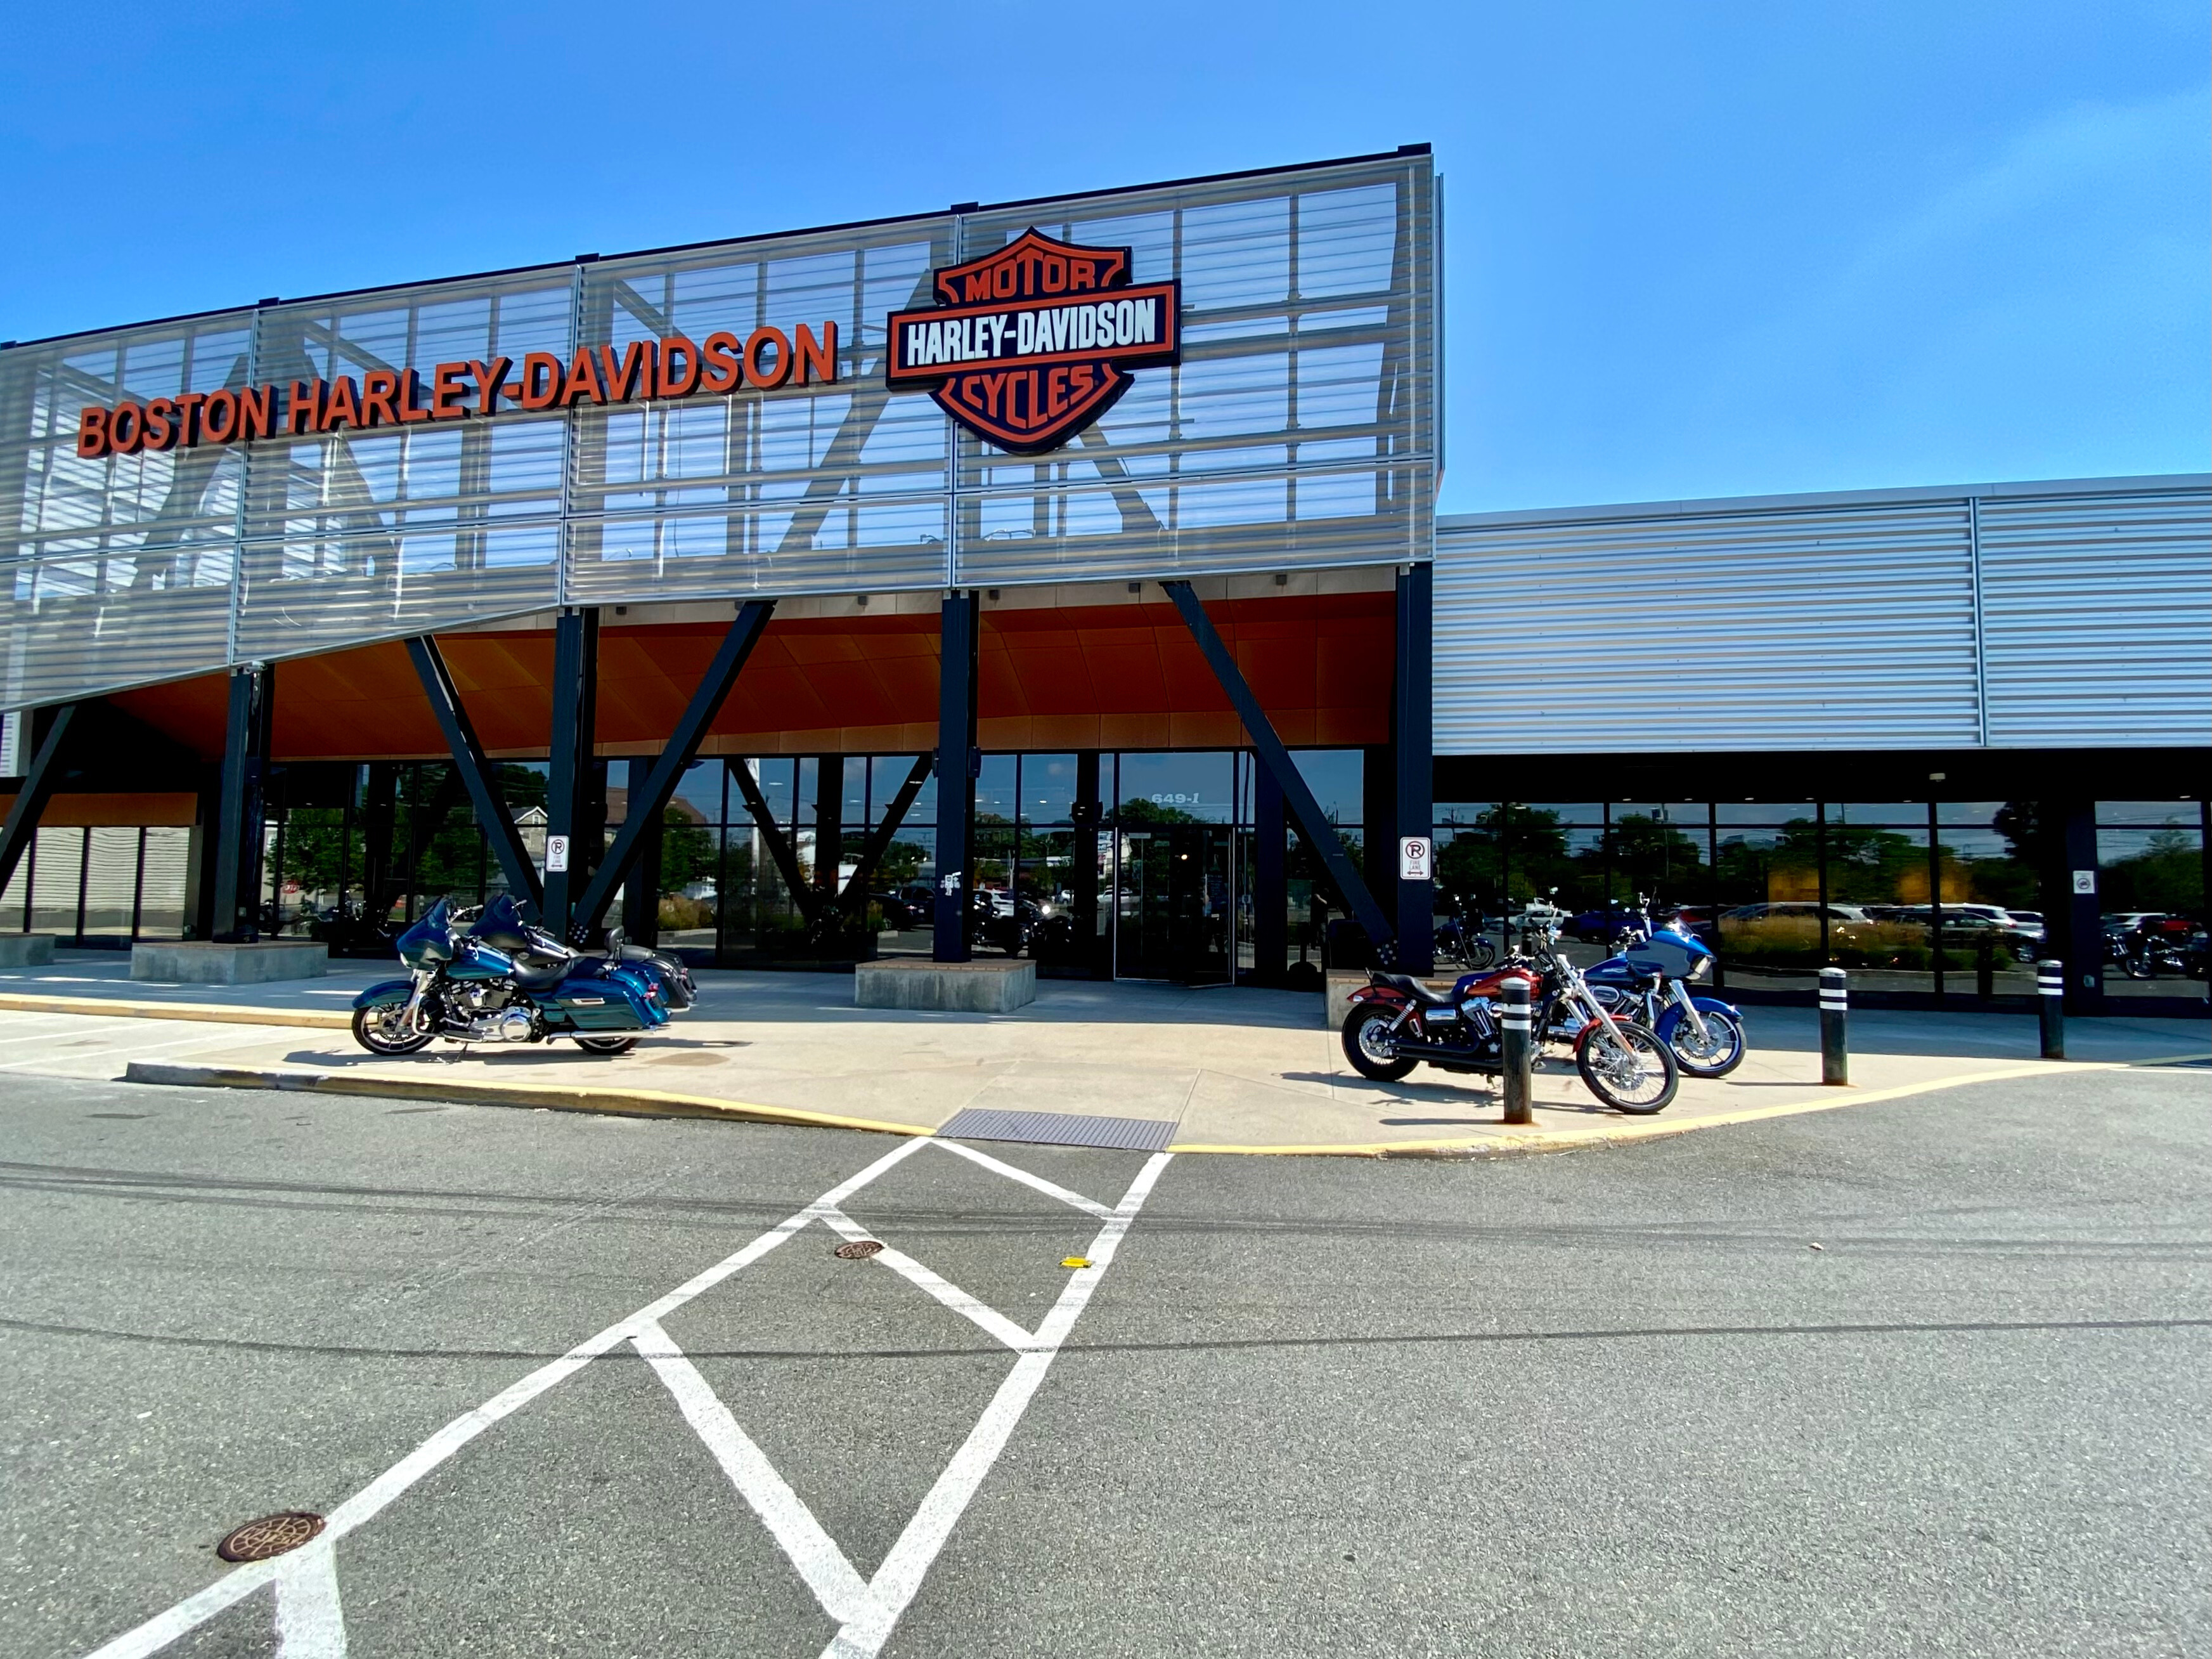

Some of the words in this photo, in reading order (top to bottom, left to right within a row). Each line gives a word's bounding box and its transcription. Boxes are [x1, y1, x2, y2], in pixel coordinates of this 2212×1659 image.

[965, 251, 1096, 302] MOTOR
[907, 298, 1156, 366] HARLEY-DAVIDSON
[77, 384, 275, 459] BOSTON
[287, 320, 838, 435] HARLEY-DAVIDSON
[962, 365, 1094, 429] CYCLES
[1151, 793, 1200, 803] 649-1
